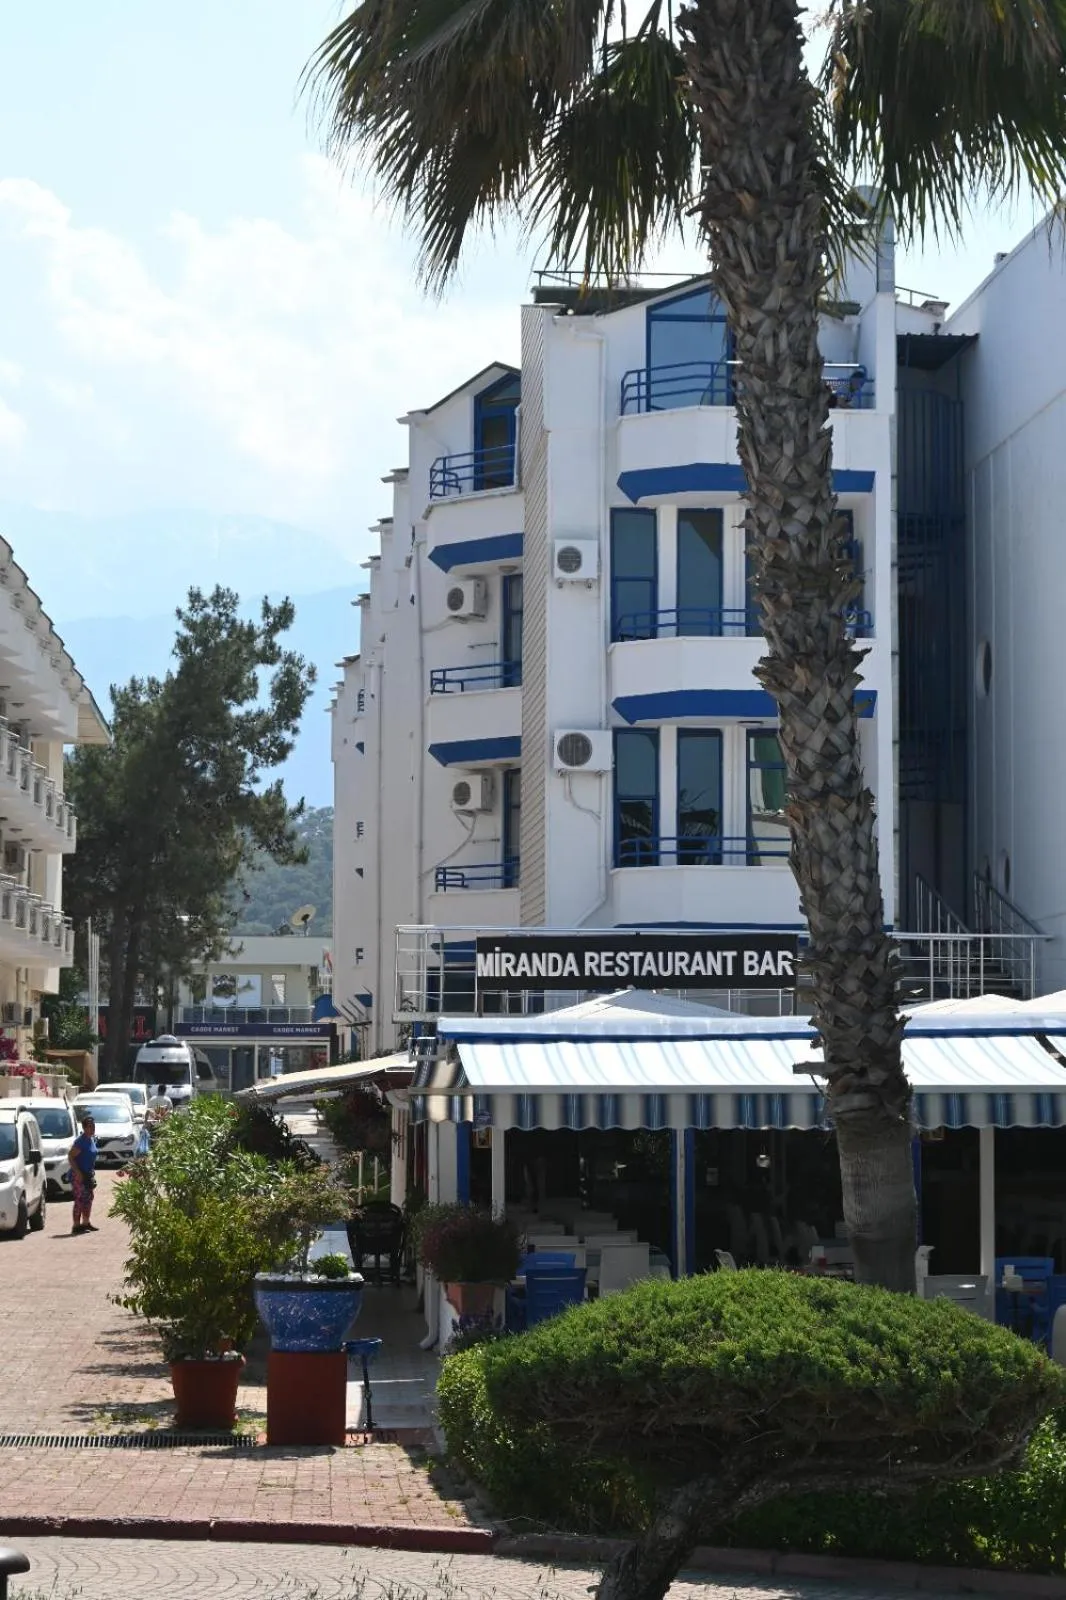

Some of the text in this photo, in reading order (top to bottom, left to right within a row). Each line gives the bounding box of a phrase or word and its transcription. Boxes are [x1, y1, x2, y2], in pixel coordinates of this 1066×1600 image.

[476, 947, 794, 977] MİRANDA RESTAURANT BAR
